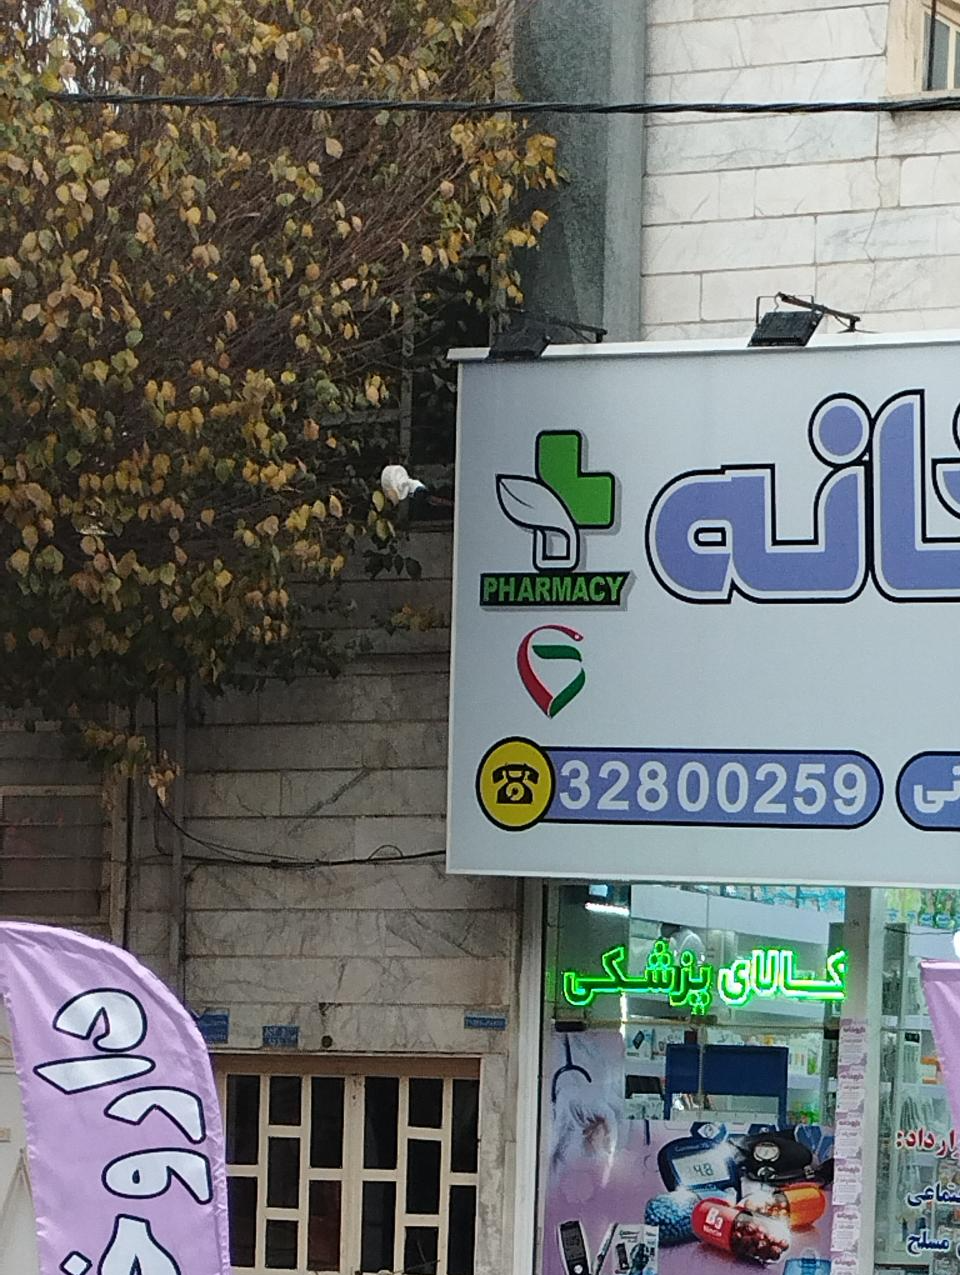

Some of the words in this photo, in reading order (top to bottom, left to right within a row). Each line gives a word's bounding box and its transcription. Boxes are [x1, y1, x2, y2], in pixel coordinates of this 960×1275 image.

[482, 576, 623, 603] PHARMACY
[559, 760, 868, 816] 32800259
[562, 938, 713, 1017] پزشکی
